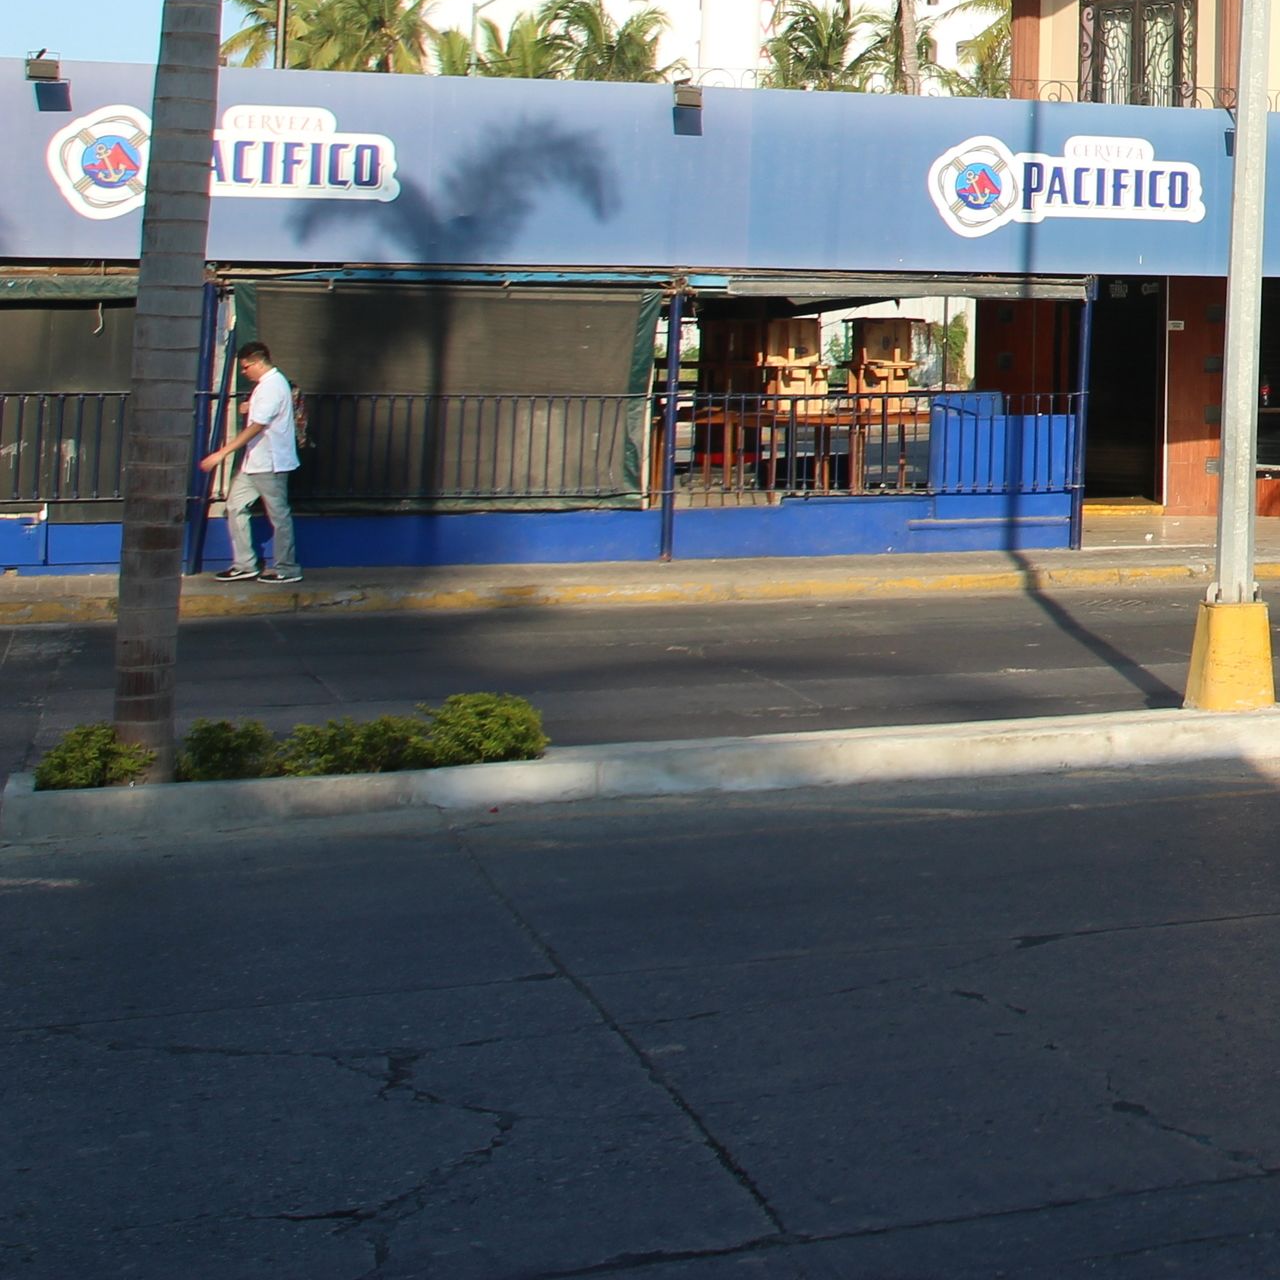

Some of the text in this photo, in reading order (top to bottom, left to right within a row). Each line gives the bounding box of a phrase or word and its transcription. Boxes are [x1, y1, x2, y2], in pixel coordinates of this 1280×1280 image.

[233, 114, 324, 135] CERVEZA
[1073, 144, 1145, 163] CERVEZA
[1022, 162, 1190, 211] PACIFICO
